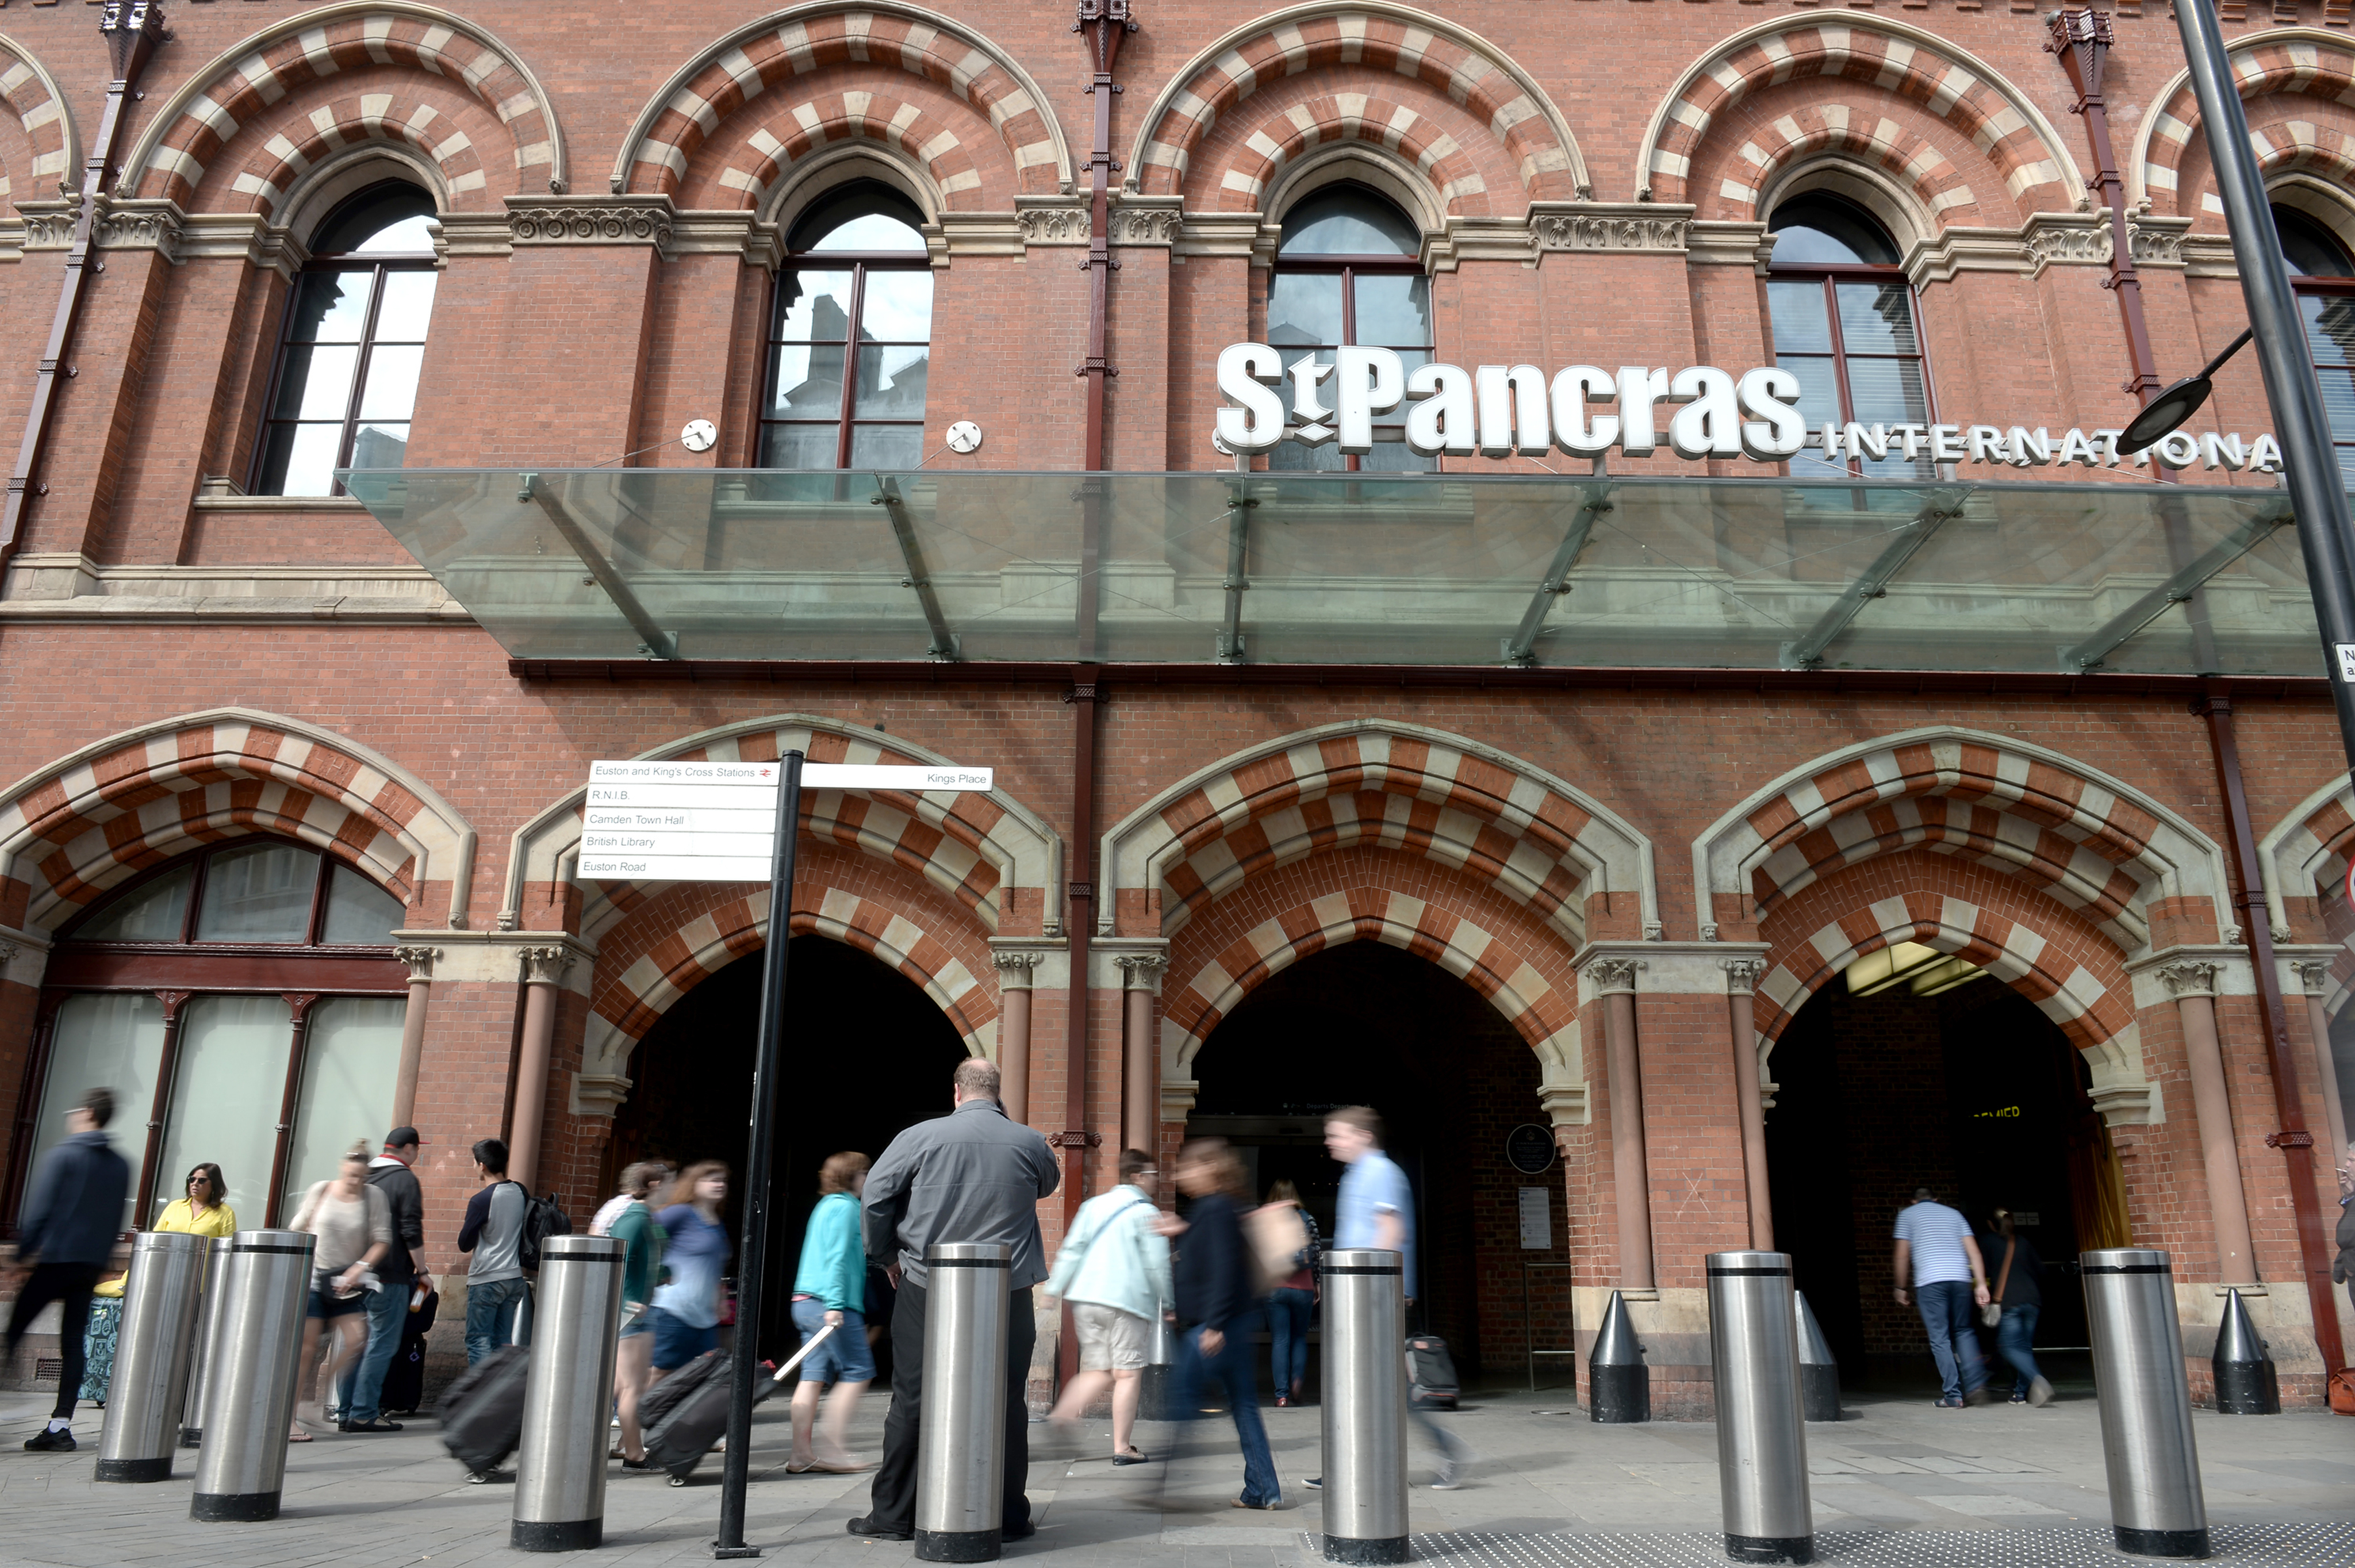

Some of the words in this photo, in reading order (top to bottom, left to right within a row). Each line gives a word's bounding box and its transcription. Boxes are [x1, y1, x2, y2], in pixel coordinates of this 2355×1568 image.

[1820, 421, 2284, 472] INTERNATONA
[596, 766, 628, 776] Euston
[632, 767, 650, 776] and
[653, 767, 682, 778] King's
[685, 768, 713, 777] Cross
[716, 768, 755, 777] Stations
[927, 774, 956, 785] Kings
[958, 774, 987, 783] Place
[592, 791, 630, 800] R.N.I.B.
[590, 815, 631, 824] Camden
[636, 815, 661, 824] Town
[665, 816, 684, 825] Hall
[587, 837, 617, 846] British
[621, 837, 655, 849] Library
[584, 861, 617, 871] Euston
[620, 862, 646, 872] Road
